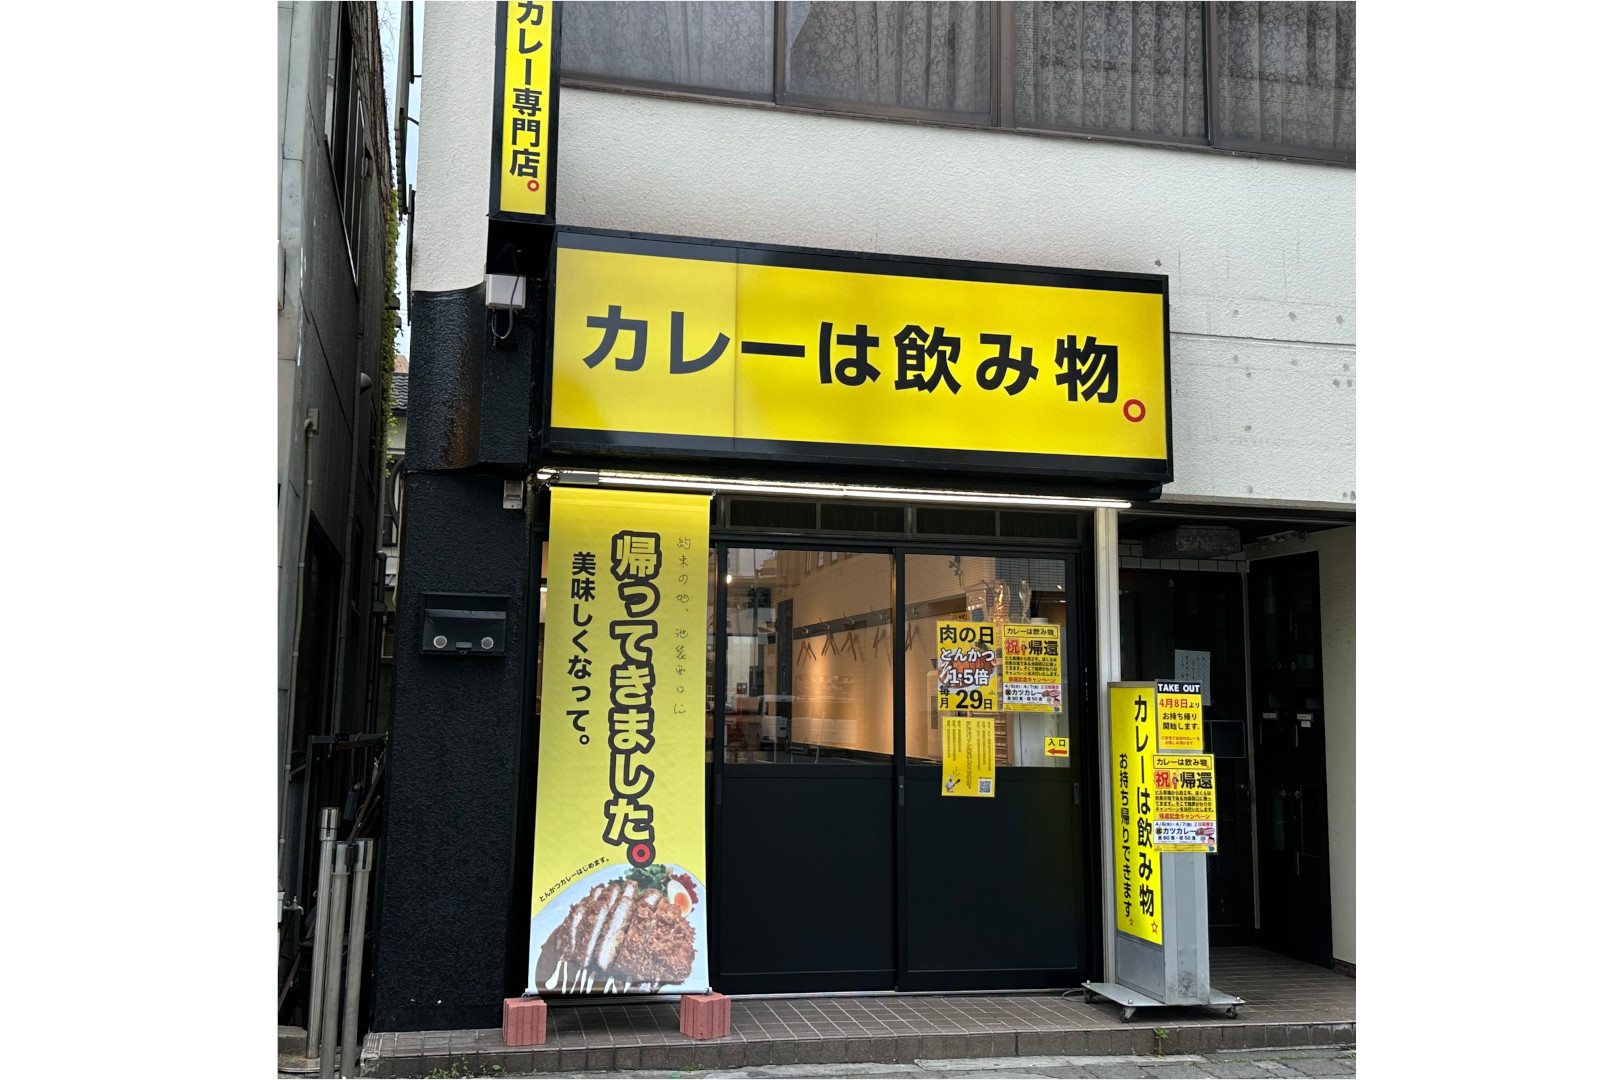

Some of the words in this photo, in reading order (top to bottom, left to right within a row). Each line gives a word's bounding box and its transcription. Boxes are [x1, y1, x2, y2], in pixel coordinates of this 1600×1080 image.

[582, 304, 1146, 423] カレーは飲み物。
[940, 625, 994, 645] 肉の日
[566, 551, 596, 746] 美味しくなって。
[940, 648, 995, 663] とんかつ
[1028, 640, 1058, 656] 帰還
[1158, 684, 1179, 692] TAKE
[1183, 684, 1200, 693] OUT
[603, 529, 661, 868] 帰ってきました。
[1159, 698, 1200, 709] 4月8日より
[1162, 712, 1197, 721] お持ち帰り
[1048, 739, 1066, 747] 入口
[1154, 770, 1170, 789] 祝
[1180, 771, 1212, 789] 帰還
[539, 856, 610, 902] とんかつカレーはじめます。
